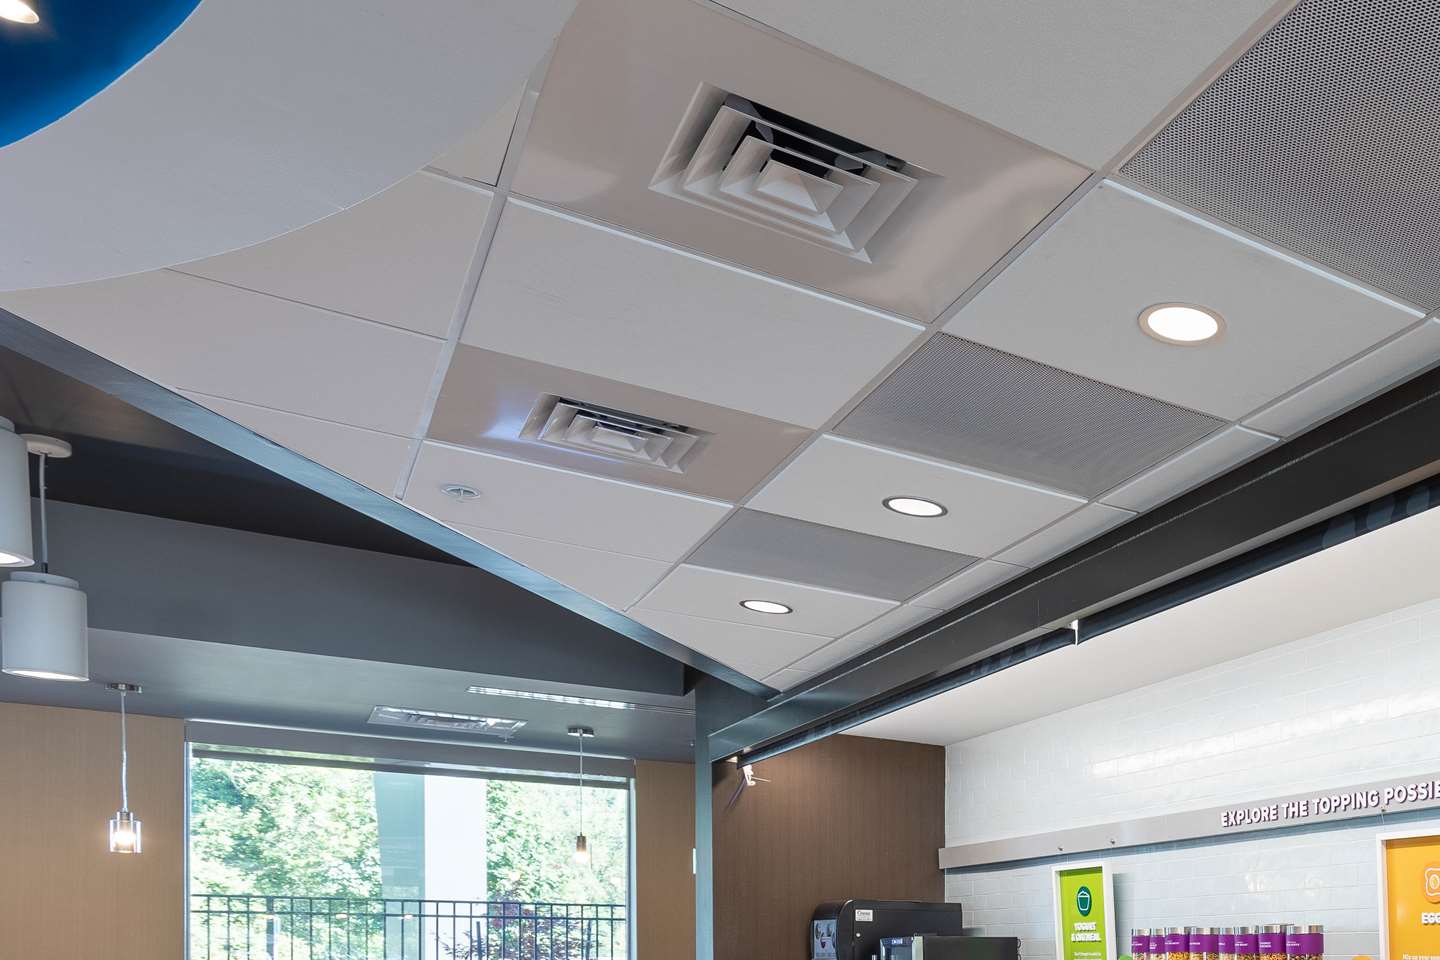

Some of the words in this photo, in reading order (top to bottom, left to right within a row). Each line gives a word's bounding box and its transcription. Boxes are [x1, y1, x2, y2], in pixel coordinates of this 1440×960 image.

[1221, 804, 1278, 827] EXPLORE
[1282, 801, 1308, 819] THE
[1312, 790, 1381, 815] TOPPING
